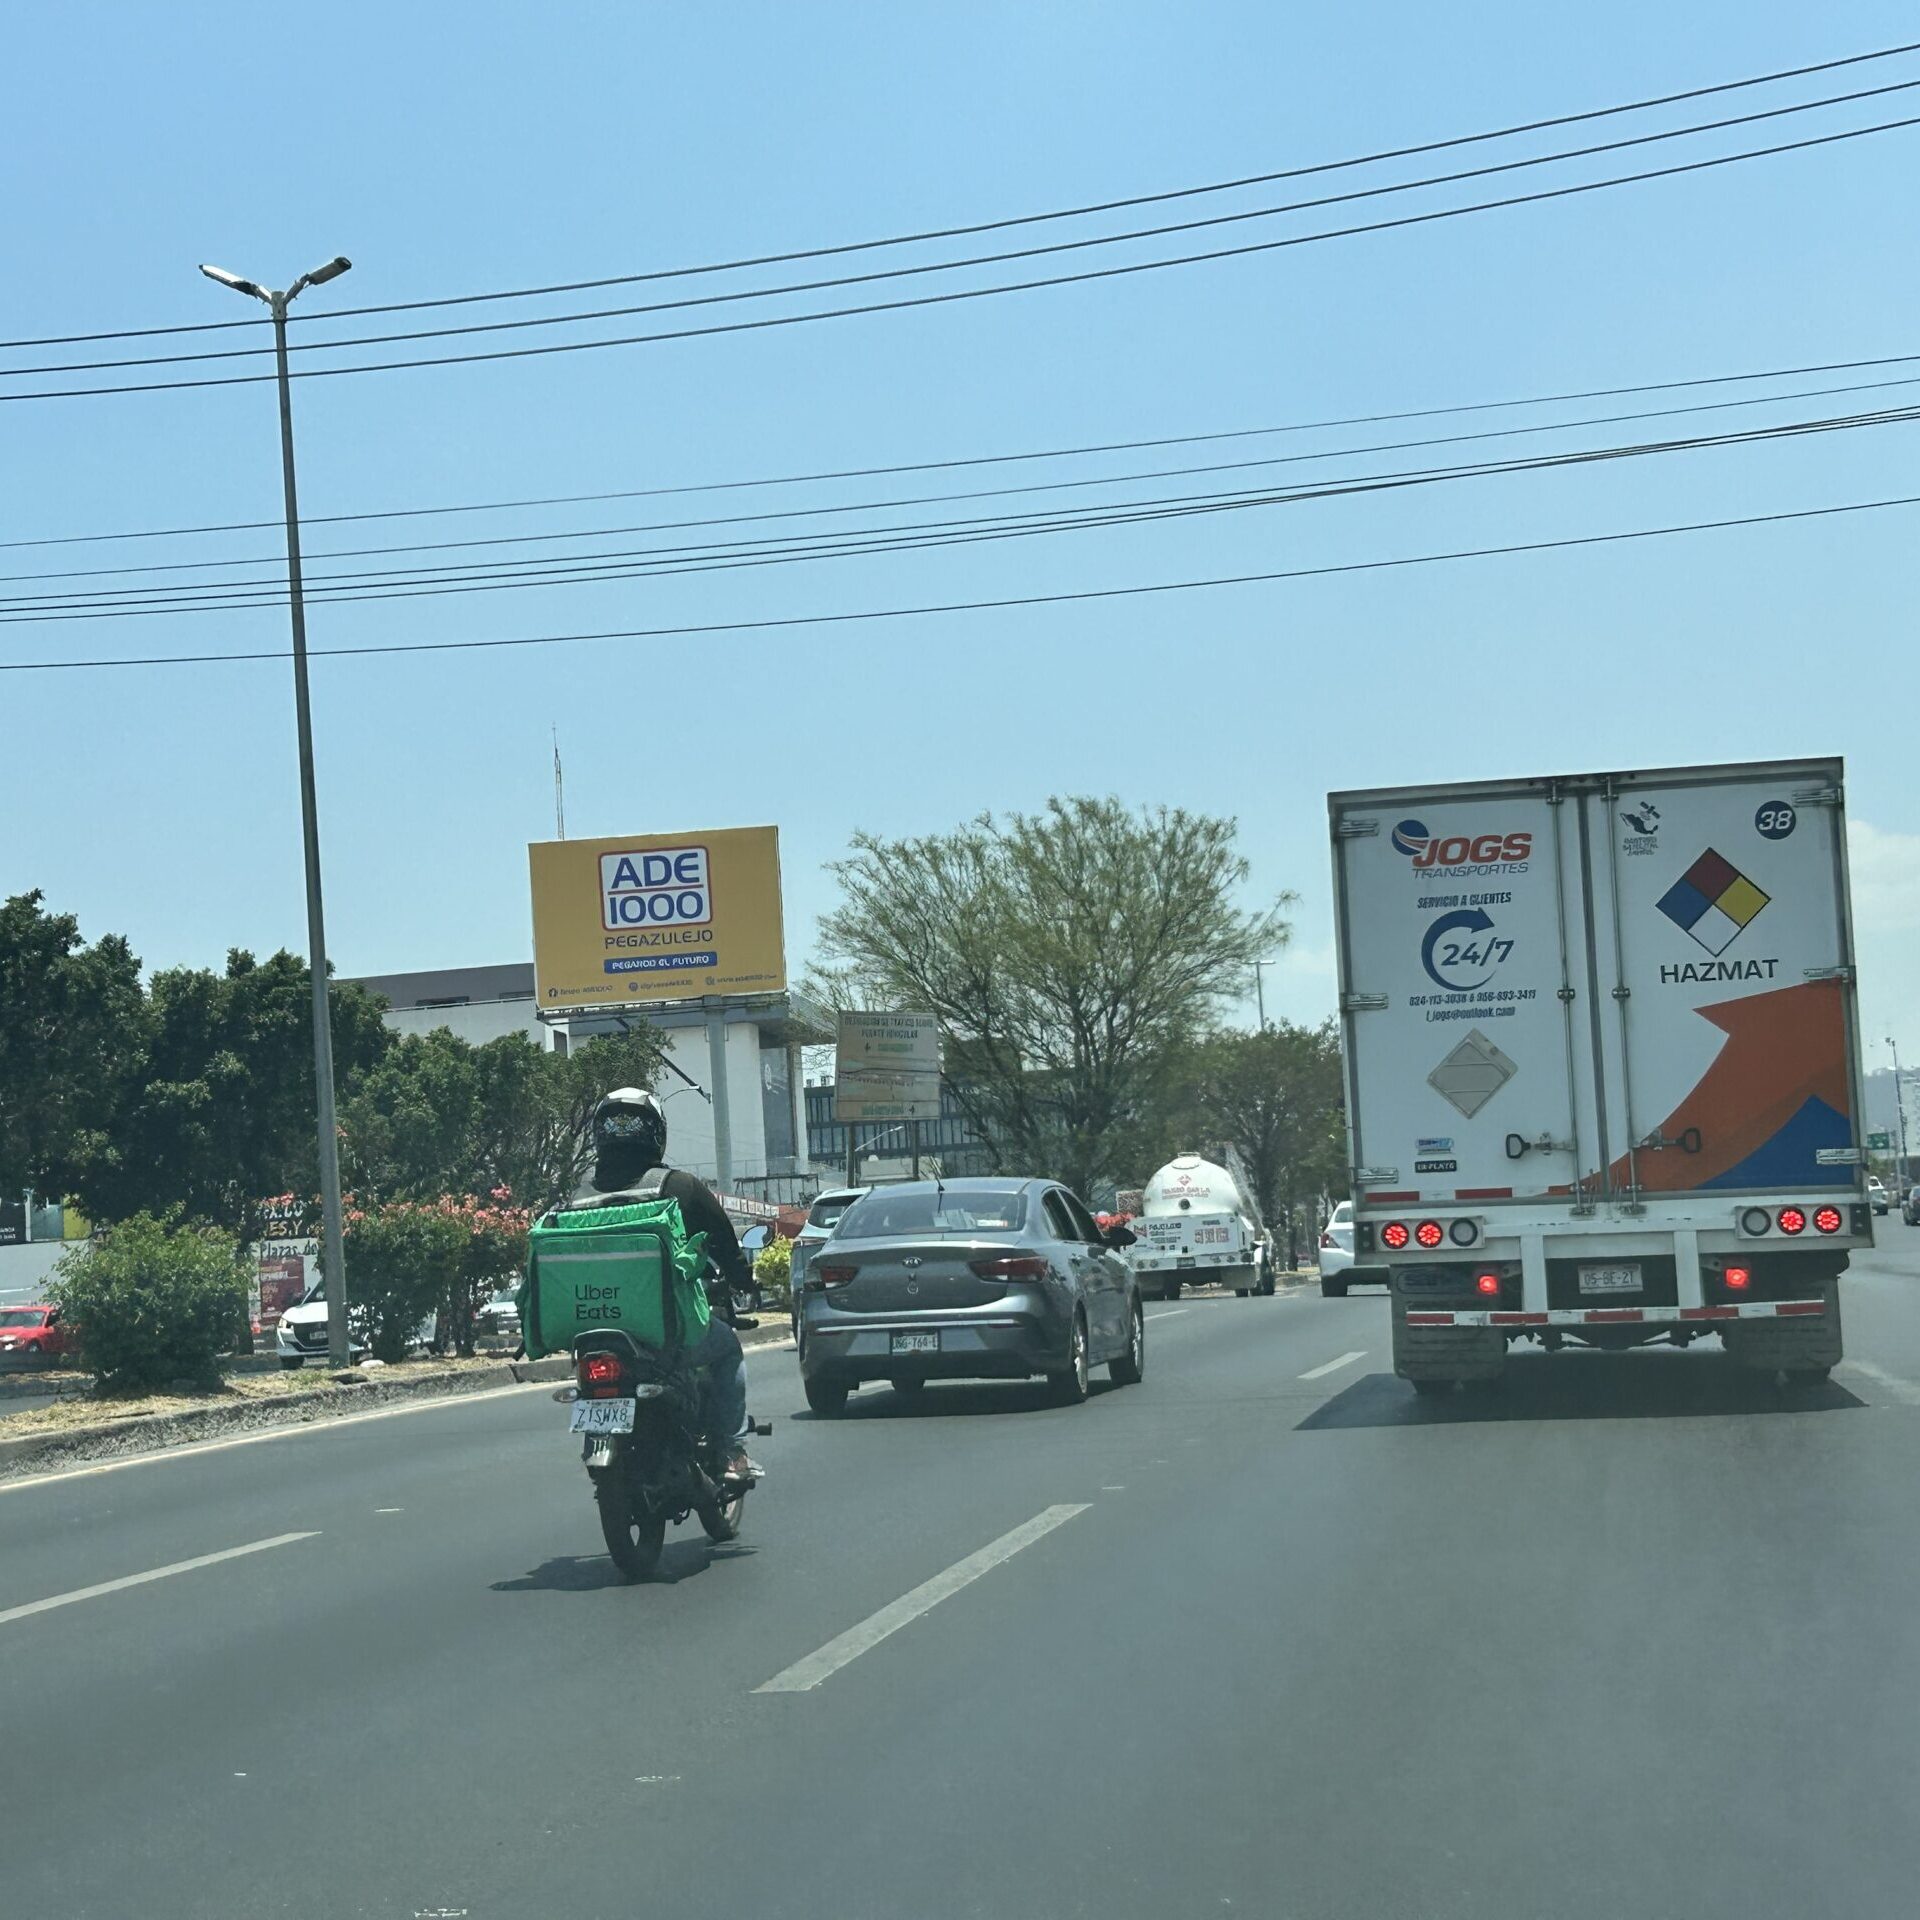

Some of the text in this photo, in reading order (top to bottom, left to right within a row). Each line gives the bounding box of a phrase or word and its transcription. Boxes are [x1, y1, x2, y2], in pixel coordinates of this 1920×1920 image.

[1759, 810, 1793, 831] 38
[1412, 833, 1532, 868] JOGS
[611, 852, 700, 889] ADE
[1412, 862, 1529, 879] TRANSPORTES
[1417, 891, 1512, 909] SERVICIO A CLIENTES
[604, 929, 713, 950] PEGAZULEJO
[612, 959, 656, 970] PEGANDO
[672, 955, 710, 967] FUTURO
[1441, 937, 1514, 967] 24/7
[1660, 959, 1779, 984] HAZMAT
[575, 1285, 621, 1300] Uber
[576, 1304, 621, 1320] Eats
